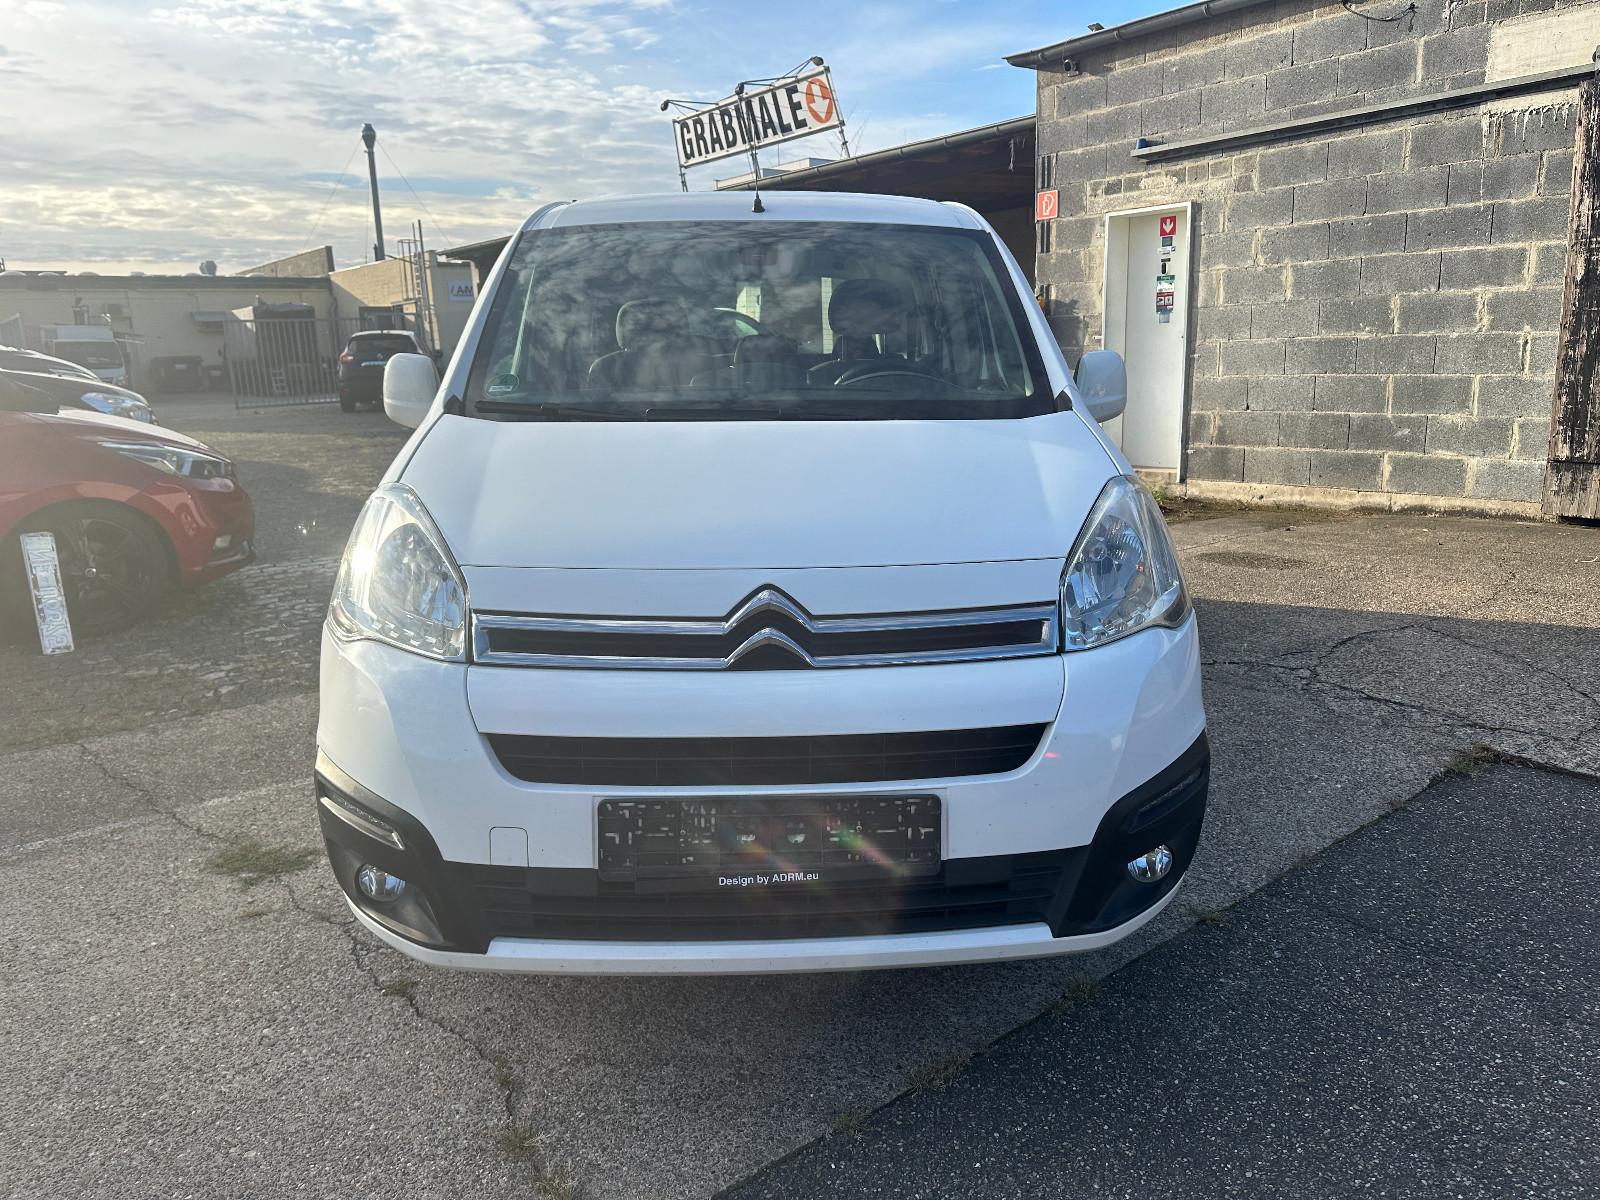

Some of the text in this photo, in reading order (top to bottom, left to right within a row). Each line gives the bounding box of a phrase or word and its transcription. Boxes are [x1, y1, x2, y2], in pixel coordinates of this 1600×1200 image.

[680, 84, 808, 161] GRABMALE
[718, 872, 819, 887] Design by ADRM.eu
